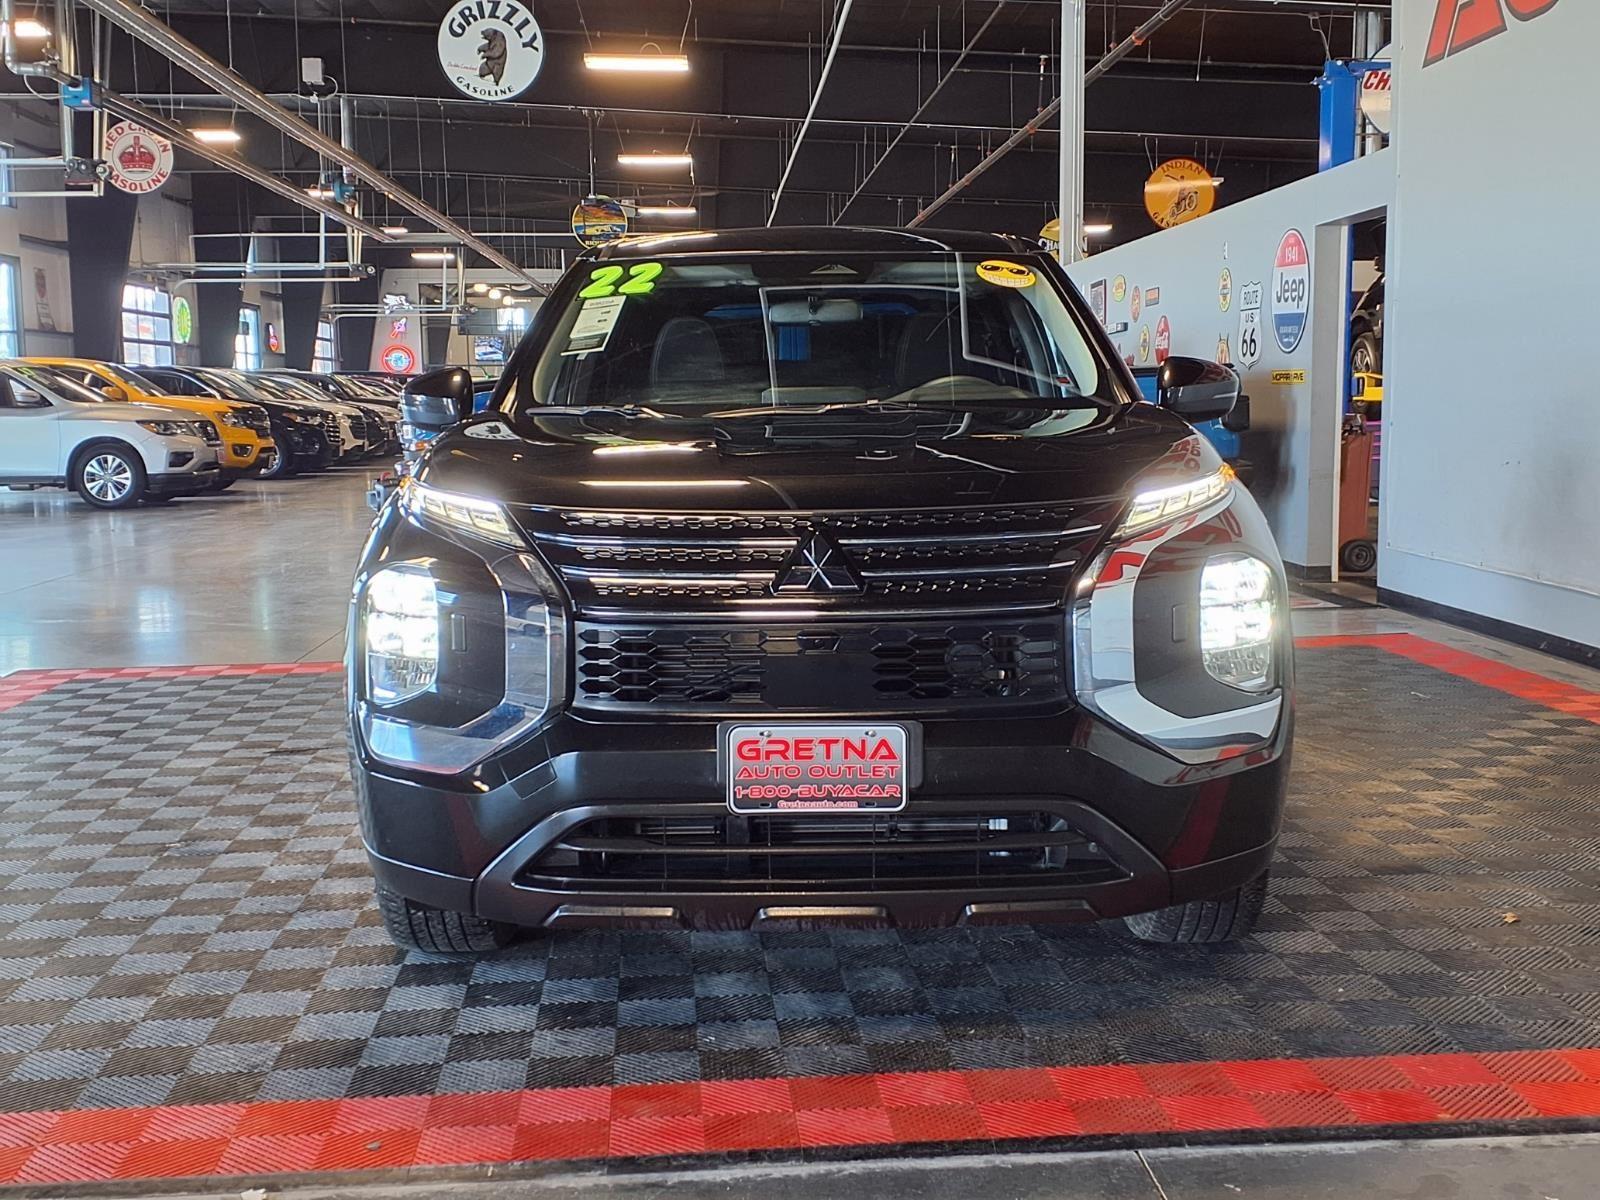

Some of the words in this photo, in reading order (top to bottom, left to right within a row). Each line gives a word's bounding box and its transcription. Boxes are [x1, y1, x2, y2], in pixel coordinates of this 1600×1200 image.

[448, 0, 539, 53] GRIZZLY
[456, 76, 515, 97] GASOLINE
[1160, 160, 1203, 175] INDIAN
[1285, 246, 1299, 262] 1941
[579, 262, 663, 298] 22
[1243, 289, 1259, 306] ROUTE
[1276, 272, 1305, 309] Jeep
[1245, 312, 1255, 323] US
[1241, 327, 1257, 358] 66
[736, 738, 899, 761] GRETNA
[736, 766, 801, 779] AUTO
[808, 765, 901, 779] OUTLET
[735, 784, 901, 798] 1-800-BUYACAR
